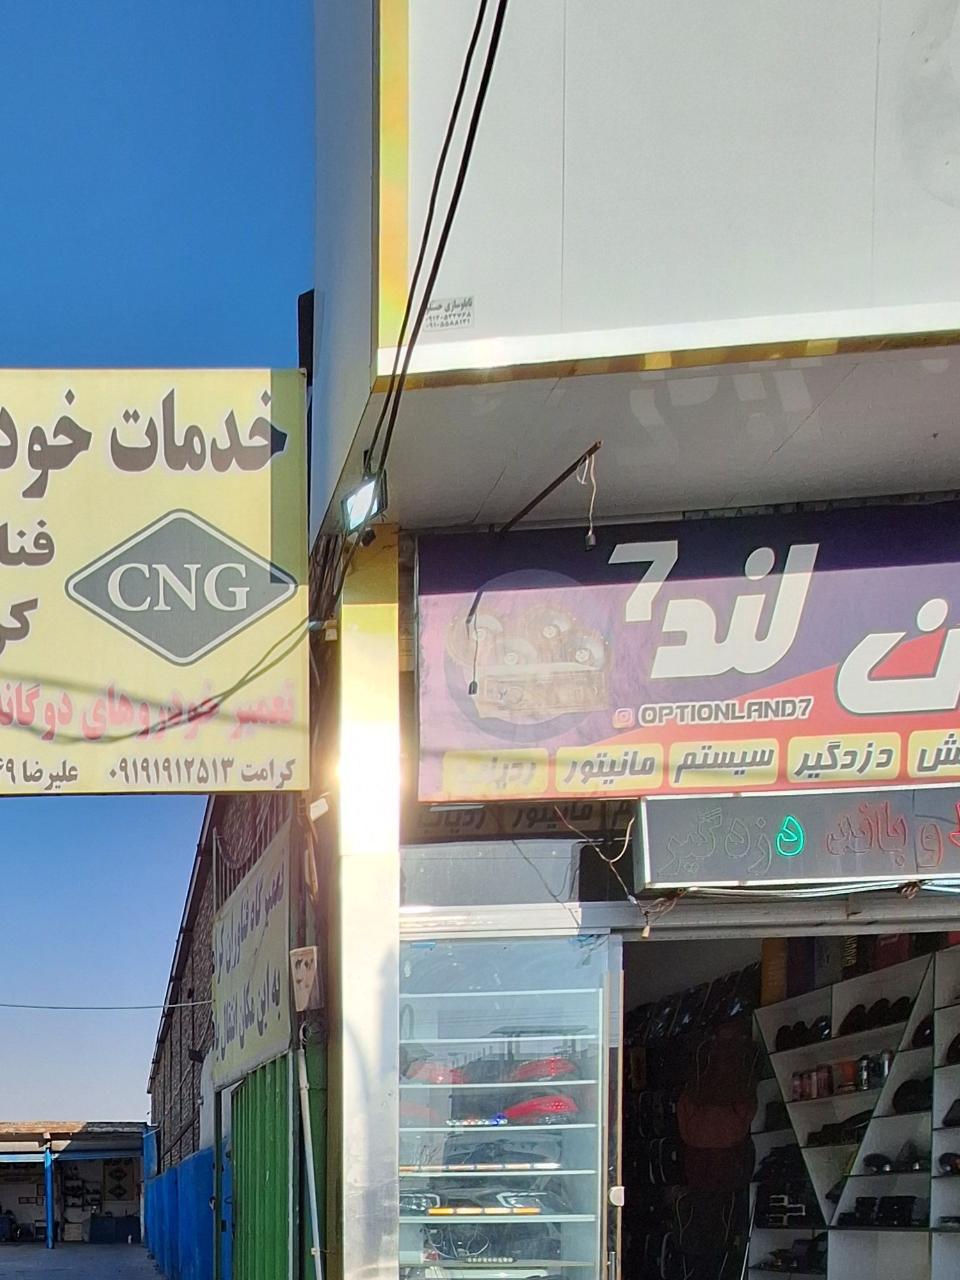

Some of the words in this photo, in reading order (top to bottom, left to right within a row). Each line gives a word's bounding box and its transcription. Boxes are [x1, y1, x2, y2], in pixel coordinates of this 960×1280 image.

[110, 382, 288, 474] خدمات
[106, 561, 251, 613] CNG
[649, 543, 821, 681] لند
[229, 681, 294, 740] تعمیر
[638, 697, 814, 728] OPTIONLAND7
[21, 759, 79, 790] علیرضا
[109, 756, 235, 784] ۰۹۱۹۱۹۱۲۵۱۳
[240, 758, 297, 789] کرامت
[563, 750, 656, 785] مانیتور
[672, 742, 776, 786] سیستم
[793, 739, 895, 780] دزدگیر
